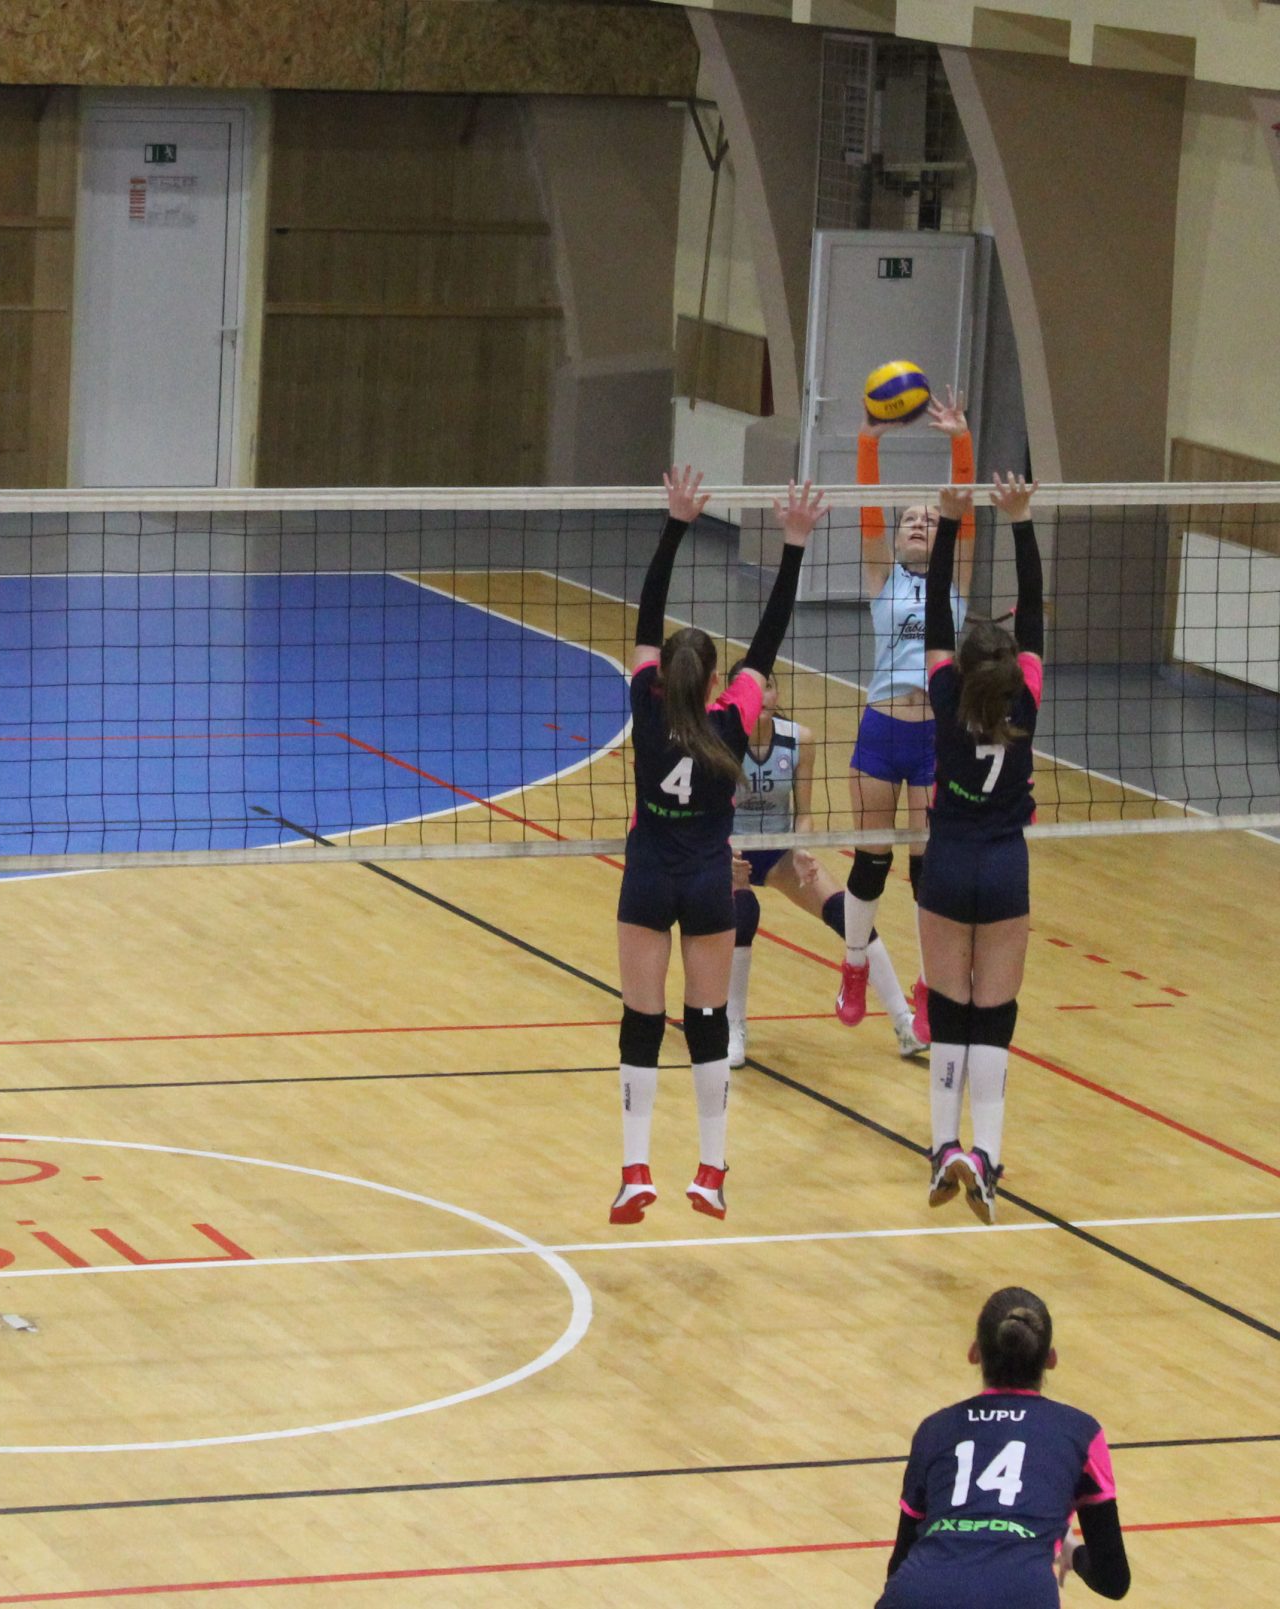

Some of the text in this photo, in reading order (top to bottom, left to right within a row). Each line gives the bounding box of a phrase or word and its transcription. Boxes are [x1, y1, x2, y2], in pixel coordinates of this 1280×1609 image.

[660, 757, 694, 805] 4
[750, 770, 774, 793] 15
[976, 744, 1005, 793] 7
[967, 1409, 1027, 1422] LUPU
[951, 1440, 1026, 1507] 14
